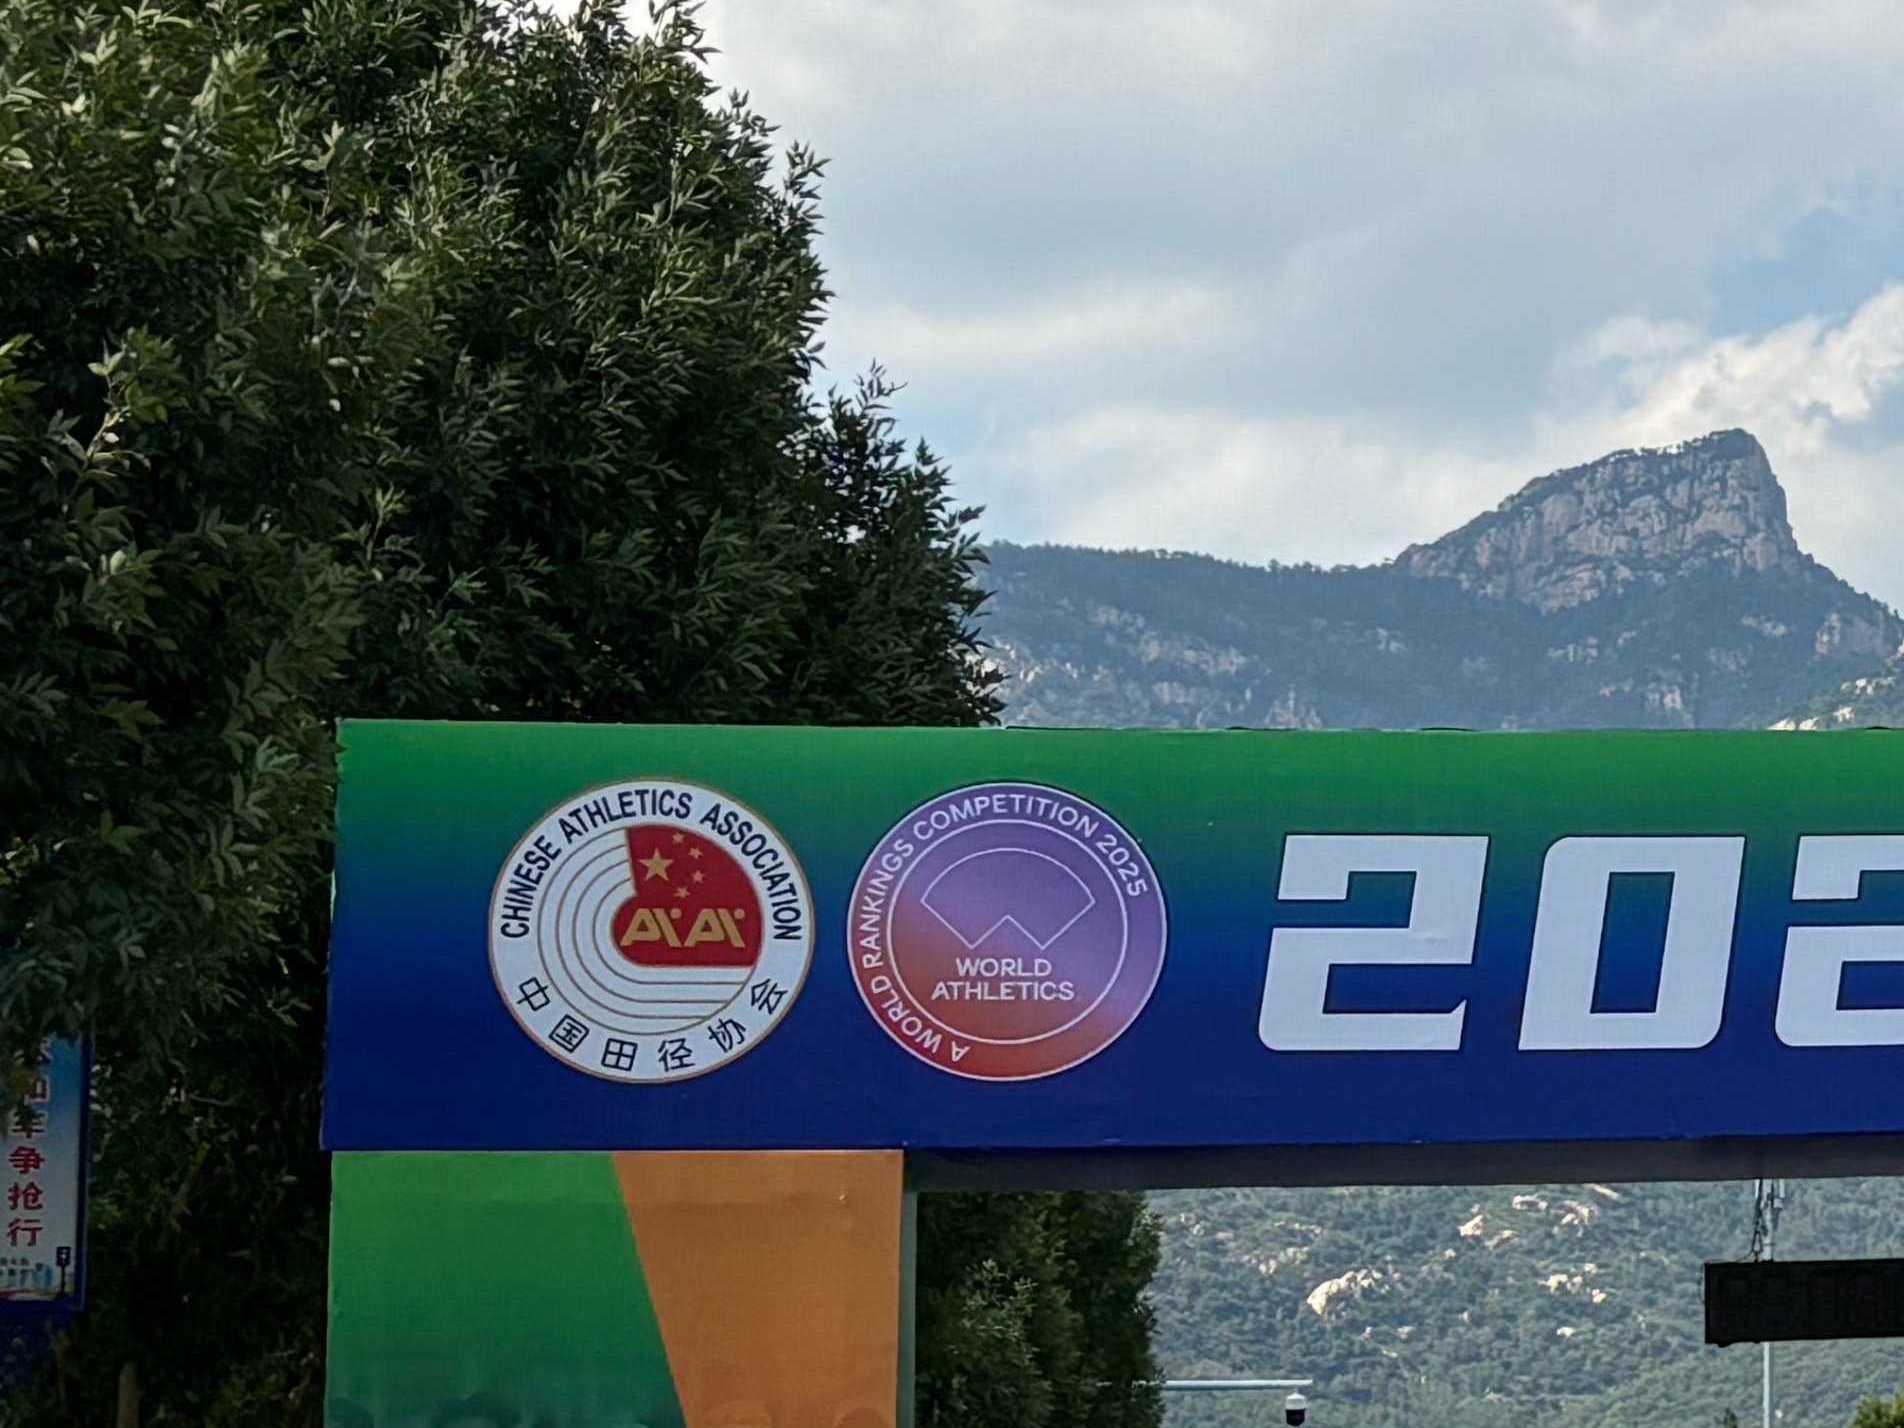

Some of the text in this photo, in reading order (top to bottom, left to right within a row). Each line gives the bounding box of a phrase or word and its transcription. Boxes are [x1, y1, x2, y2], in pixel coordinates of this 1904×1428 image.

[500, 788, 803, 941] CHINESE ATHLETICS ASSOCIATION
[860, 793, 1148, 1062] A WORLD RANKINGS COMPETITION 2025
[955, 958, 1052, 977] WORLD
[516, 976, 789, 1072] 中国田径协会
[931, 982, 1074, 1001] ATHLETICS
